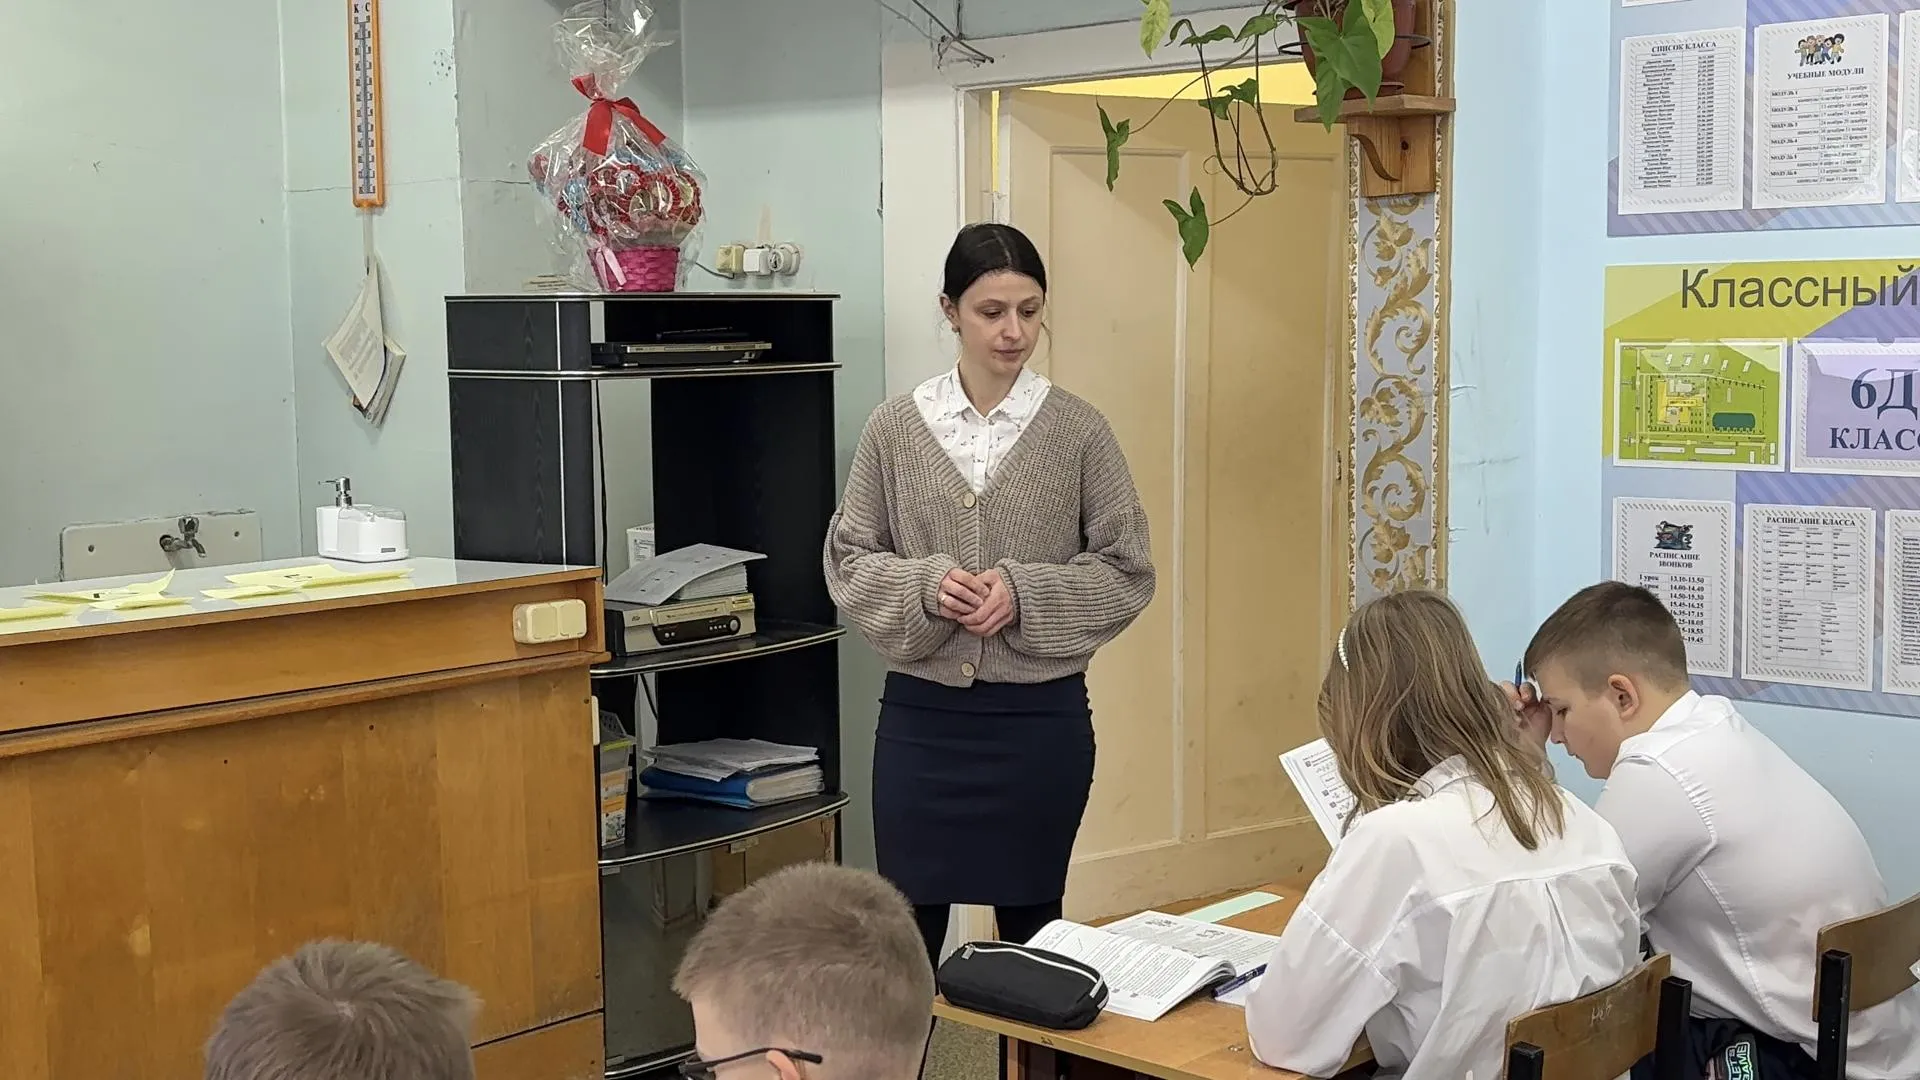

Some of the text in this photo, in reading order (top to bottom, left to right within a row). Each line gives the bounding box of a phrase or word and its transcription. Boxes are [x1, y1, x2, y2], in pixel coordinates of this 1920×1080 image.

[1652, 42, 1717, 53] СПИСОК КЛАССА
[1787, 67, 1864, 80] УЧЕБНЫЕ МОДУЛИ
[1682, 264, 1918, 308] Классный
[1851, 368, 1919, 421] 6Д
[1829, 427, 1920, 451] КЛАС
[1766, 516, 1856, 527] РАСПИСАНИЕ КЛАССА
[1649, 551, 1701, 561] РАСПИСАНИЕ
[1659, 560, 1693, 569] ЗВОНКОВ
